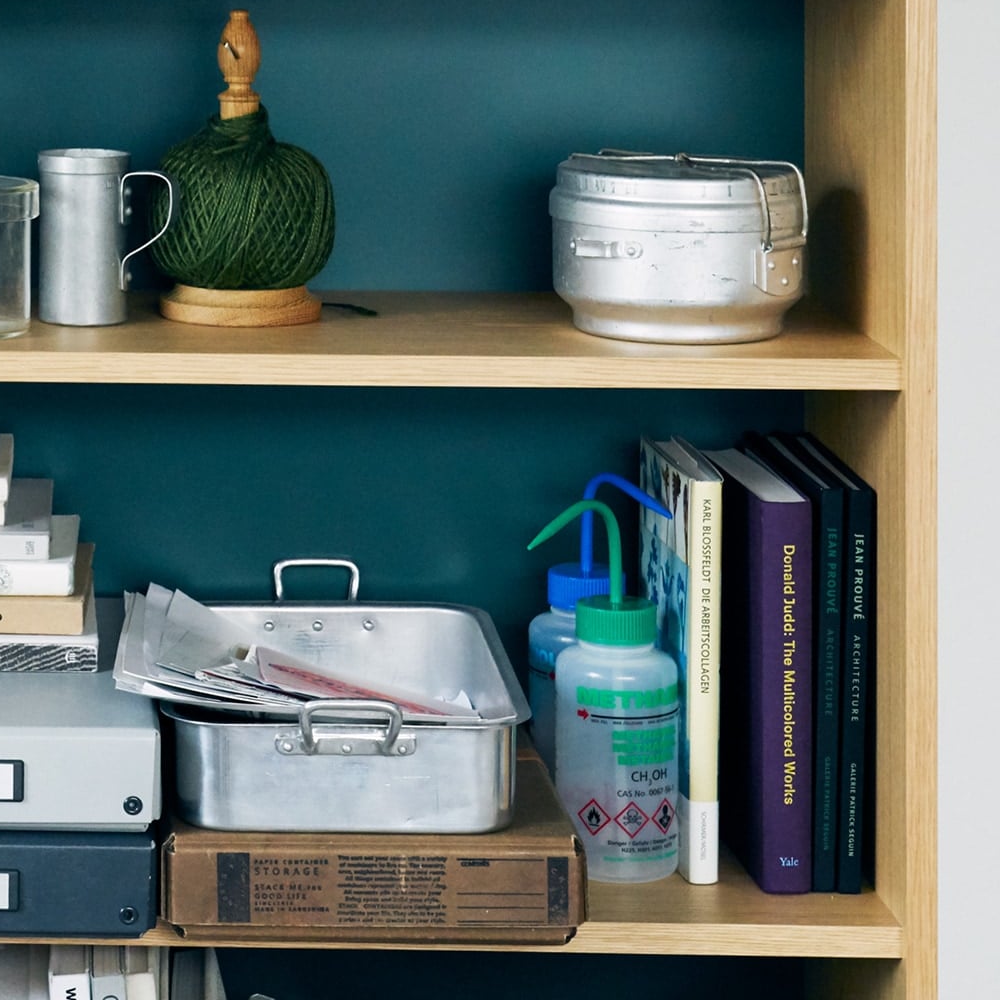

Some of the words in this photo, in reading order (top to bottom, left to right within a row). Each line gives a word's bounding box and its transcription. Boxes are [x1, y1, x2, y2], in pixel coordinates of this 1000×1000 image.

[702, 499, 712, 522] KARL
[701, 526, 711, 583] BLOSSFELDT
[827, 527, 838, 558] JEAN
[854, 533, 865, 563] JEAN
[783, 544, 796, 595] Donald
[826, 562, 839, 615] PROUVÉ
[701, 588, 711, 603] DIE
[853, 568, 866, 620] PROUVÉ
[783, 598, 796, 637] Judd:
[700, 605, 711, 694] ARBEITSCOLLAGEN
[783, 640, 796, 666] The
[824, 628, 834, 717] ARCHITECTURE
[851, 634, 861, 722] ARCHITECTURE
[783, 670, 796, 757] Multicolored
[616, 789, 633, 798] CAS
[783, 761, 797, 806] Works
[848, 796, 856, 827] PATRICK
[254, 866, 320, 876] STORAGE
[779, 856, 800, 867] Yale
